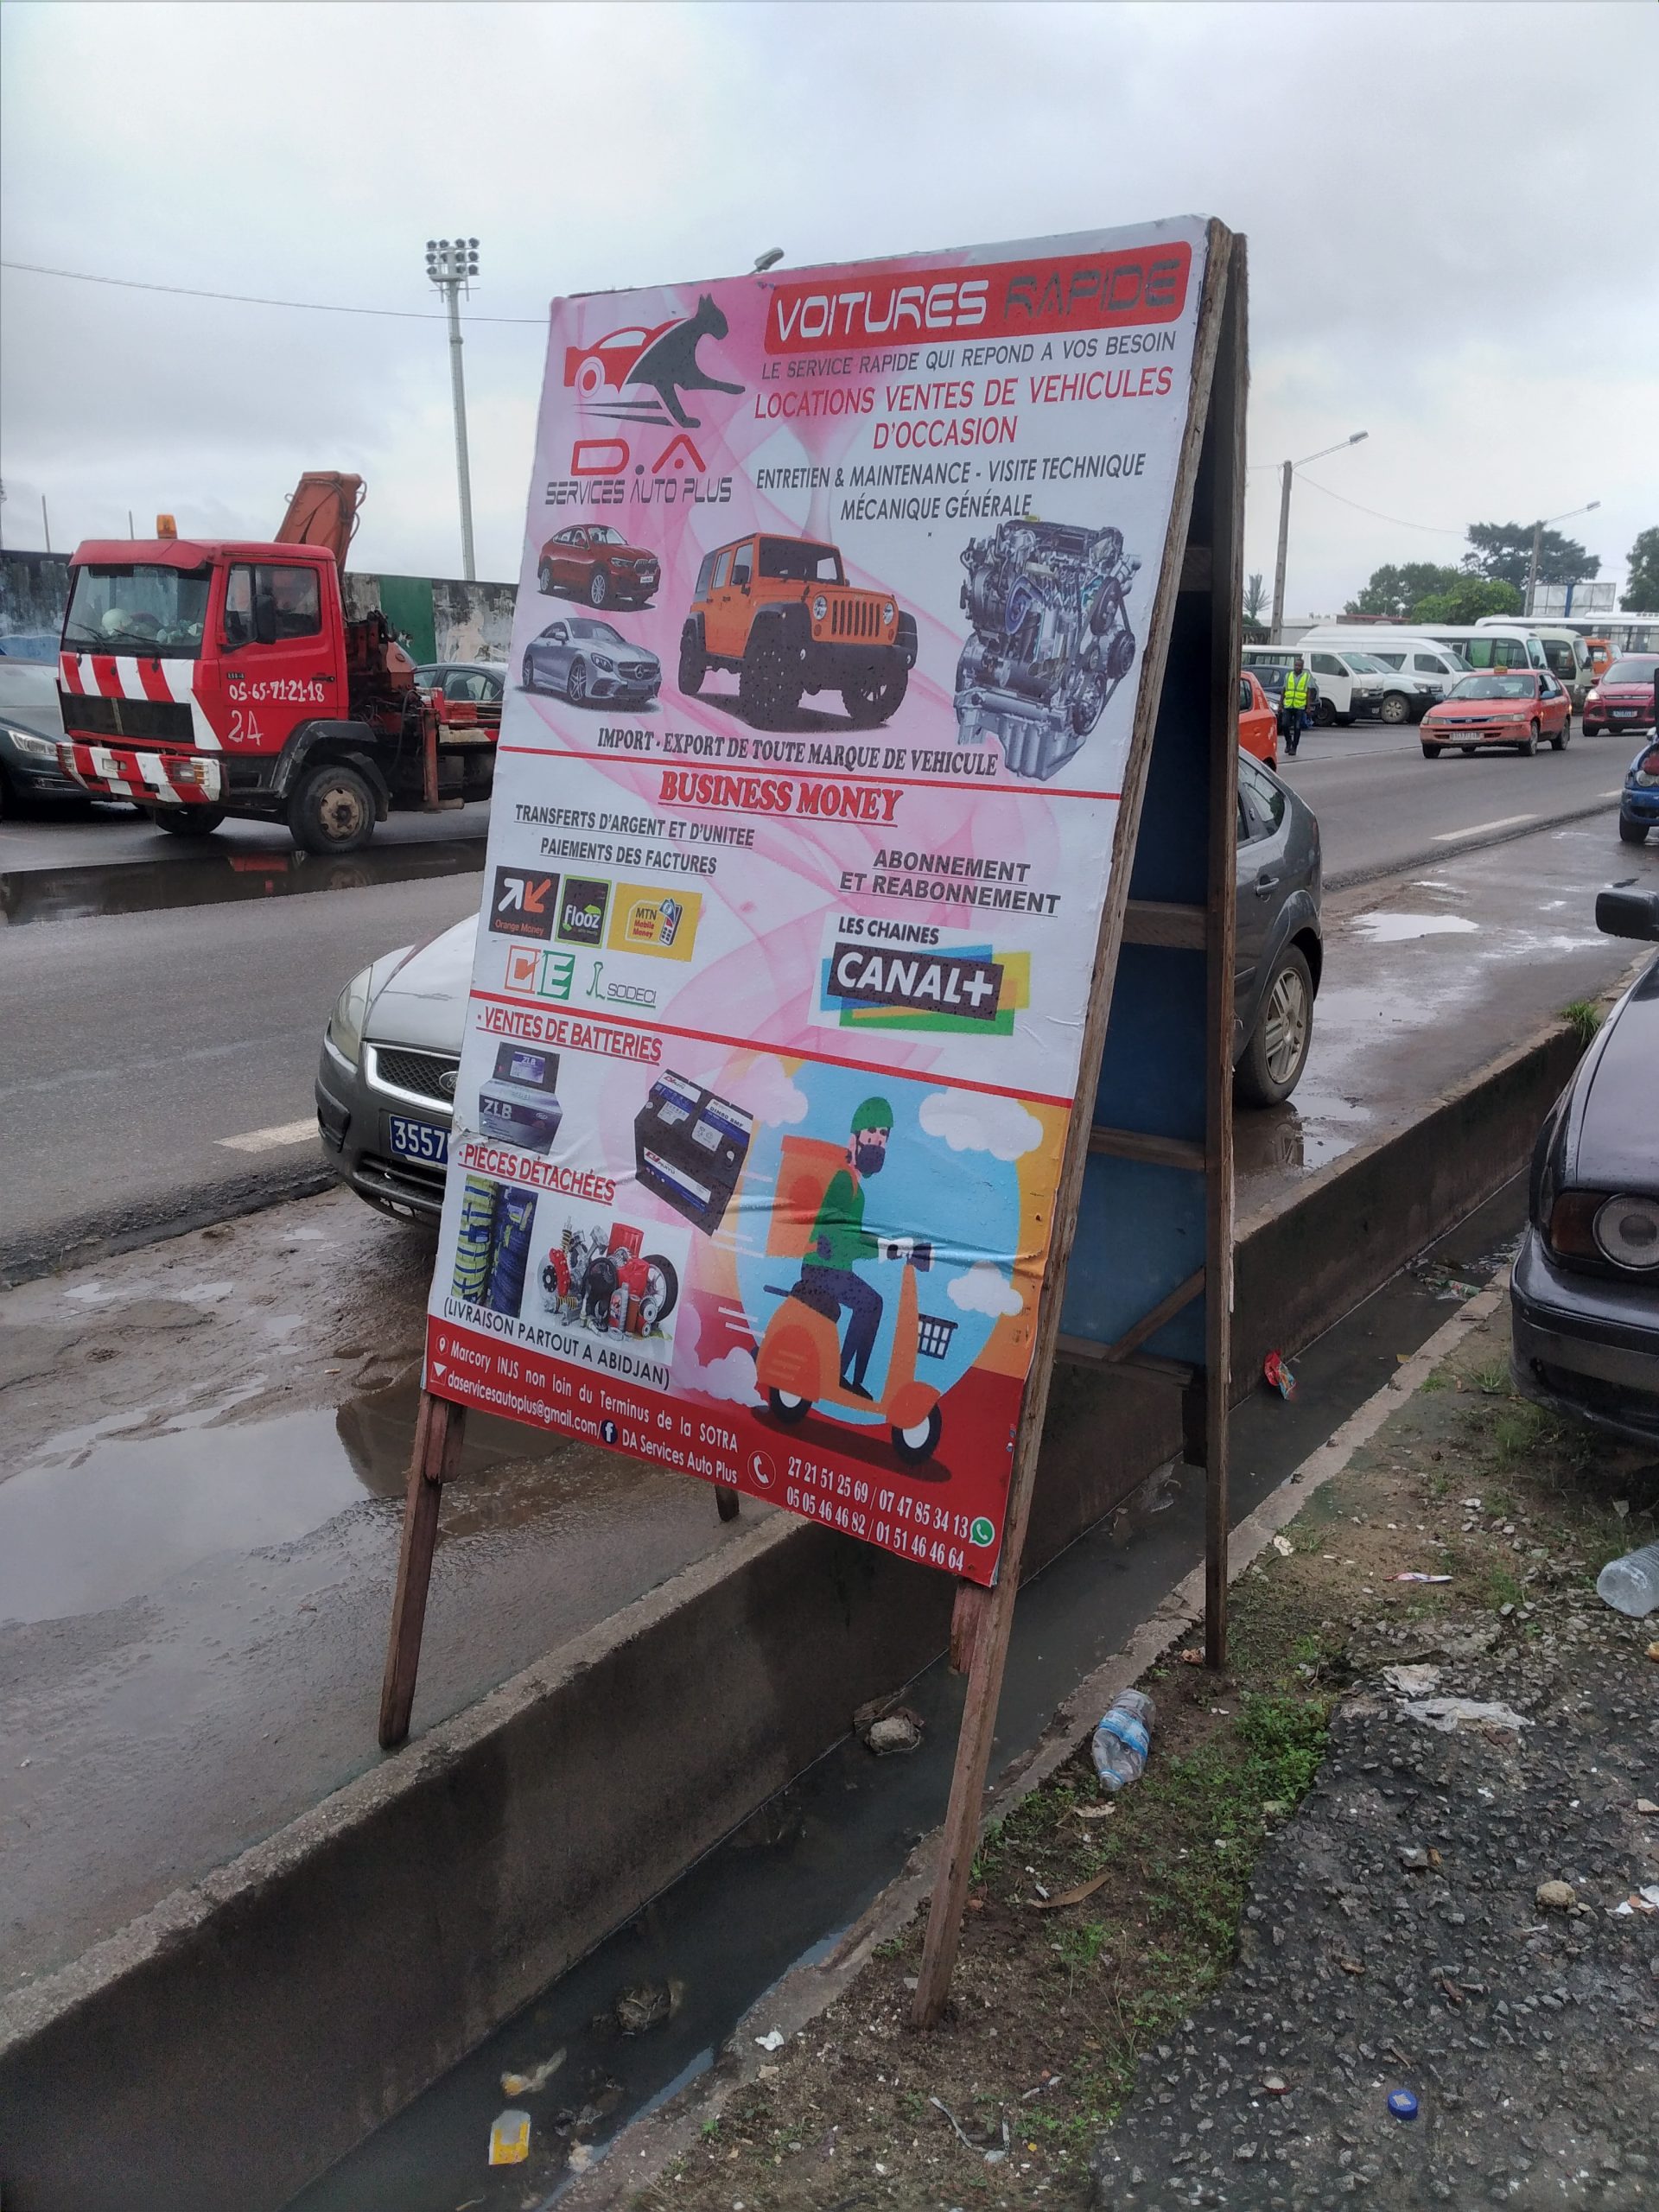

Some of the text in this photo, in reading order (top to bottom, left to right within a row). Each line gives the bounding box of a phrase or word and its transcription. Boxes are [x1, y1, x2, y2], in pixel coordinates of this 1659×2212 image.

[778, 259, 1180, 341] VOITURES RAPIDE
[762, 331, 1177, 380] LE SERVICE RAPIDE QUI REPOND A VOS BESOIN
[754, 365, 1174, 419] LOCATIONS VENTES DE VEHICULES
[873, 415, 1018, 449] D'OCCASION
[545, 477, 733, 505] SERVICES AUTO PLUS
[756, 467, 830, 490] ENTRETIEN
[834, 467, 845, 488] &
[850, 461, 971, 486] MAINTENANCE
[988, 459, 1038, 482] VISITE
[1042, 453, 1147, 480] TECHNIQUE
[840, 490, 1033, 520] MÉCANIQUE GÉNÉRALE
[228, 709, 264, 747] 24
[597, 728, 656, 750] IMPORT
[663, 734, 724, 756] EXPORT
[726, 738, 748, 758] DE
[752, 741, 804, 761] TOUTE
[808, 745, 877, 770] MARQUE
[881, 750, 906, 769] DE
[911, 752, 997, 775] VEHICULE
[660, 771, 903, 821] BUSINESS MONEY
[515, 804, 755, 846] TRANSFERTS D'ARGENT ET D'UNITEE
[540, 837, 717, 874] PAIEMENTS DES FACTURES
[873, 849, 1031, 884] ABONNEMENT
[839, 871, 1061, 914] ET REABONNEMENT
[495, 919, 544, 937] Orange Money
[632, 928, 653, 938] Money
[633, 919, 655, 930] Mobile
[635, 907, 658, 920] MTN
[838, 916, 940, 945] LES CHAINES
[607, 983, 657, 1004] SODECI
[836, 951, 994, 1007] CANAL+
[485, 1006, 663, 1062] VENTES DE BATTERIES
[484, 1098, 512, 1120] ZLB
[393, 1120, 450, 1160] 3557
[463, 1141, 616, 1201] PIÈCES DÉTACHÉES
[444, 1297, 671, 1391] (LIVRAISON PARTOUT A ABIDJAN)
[450, 1340, 738, 1453] Marcory INJS non loin du Terminus de la SOTRA
[622, 1428, 638, 1450] DA
[640, 1434, 684, 1466] Services
[687, 1452, 713, 1476] Auto
[715, 1460, 737, 1484] Plus
[787, 1456, 802, 1478] 27
[804, 1462, 817, 1484] 21
[821, 1468, 834, 1491] 51
[837, 1474, 851, 1497] 25
[854, 1480, 868, 1503] 69
[879, 1489, 895, 1513] 07
[897, 1496, 913, 1519] 47
[914, 1502, 931, 1525] 85
[933, 1507, 950, 1532] 34
[954, 1515, 969, 1539] 13
[786, 1486, 800, 1509] 05
[802, 1492, 816, 1515] 05
[818, 1499, 832, 1522] 46
[835, 1505, 849, 1528] 46
[851, 1512, 866, 1535] 82
[876, 1522, 890, 1545] 01
[893, 1528, 908, 1551] 51
[912, 1535, 926, 1558] 46
[930, 1541, 945, 1565] 46
[948, 1548, 964, 1572] 64
